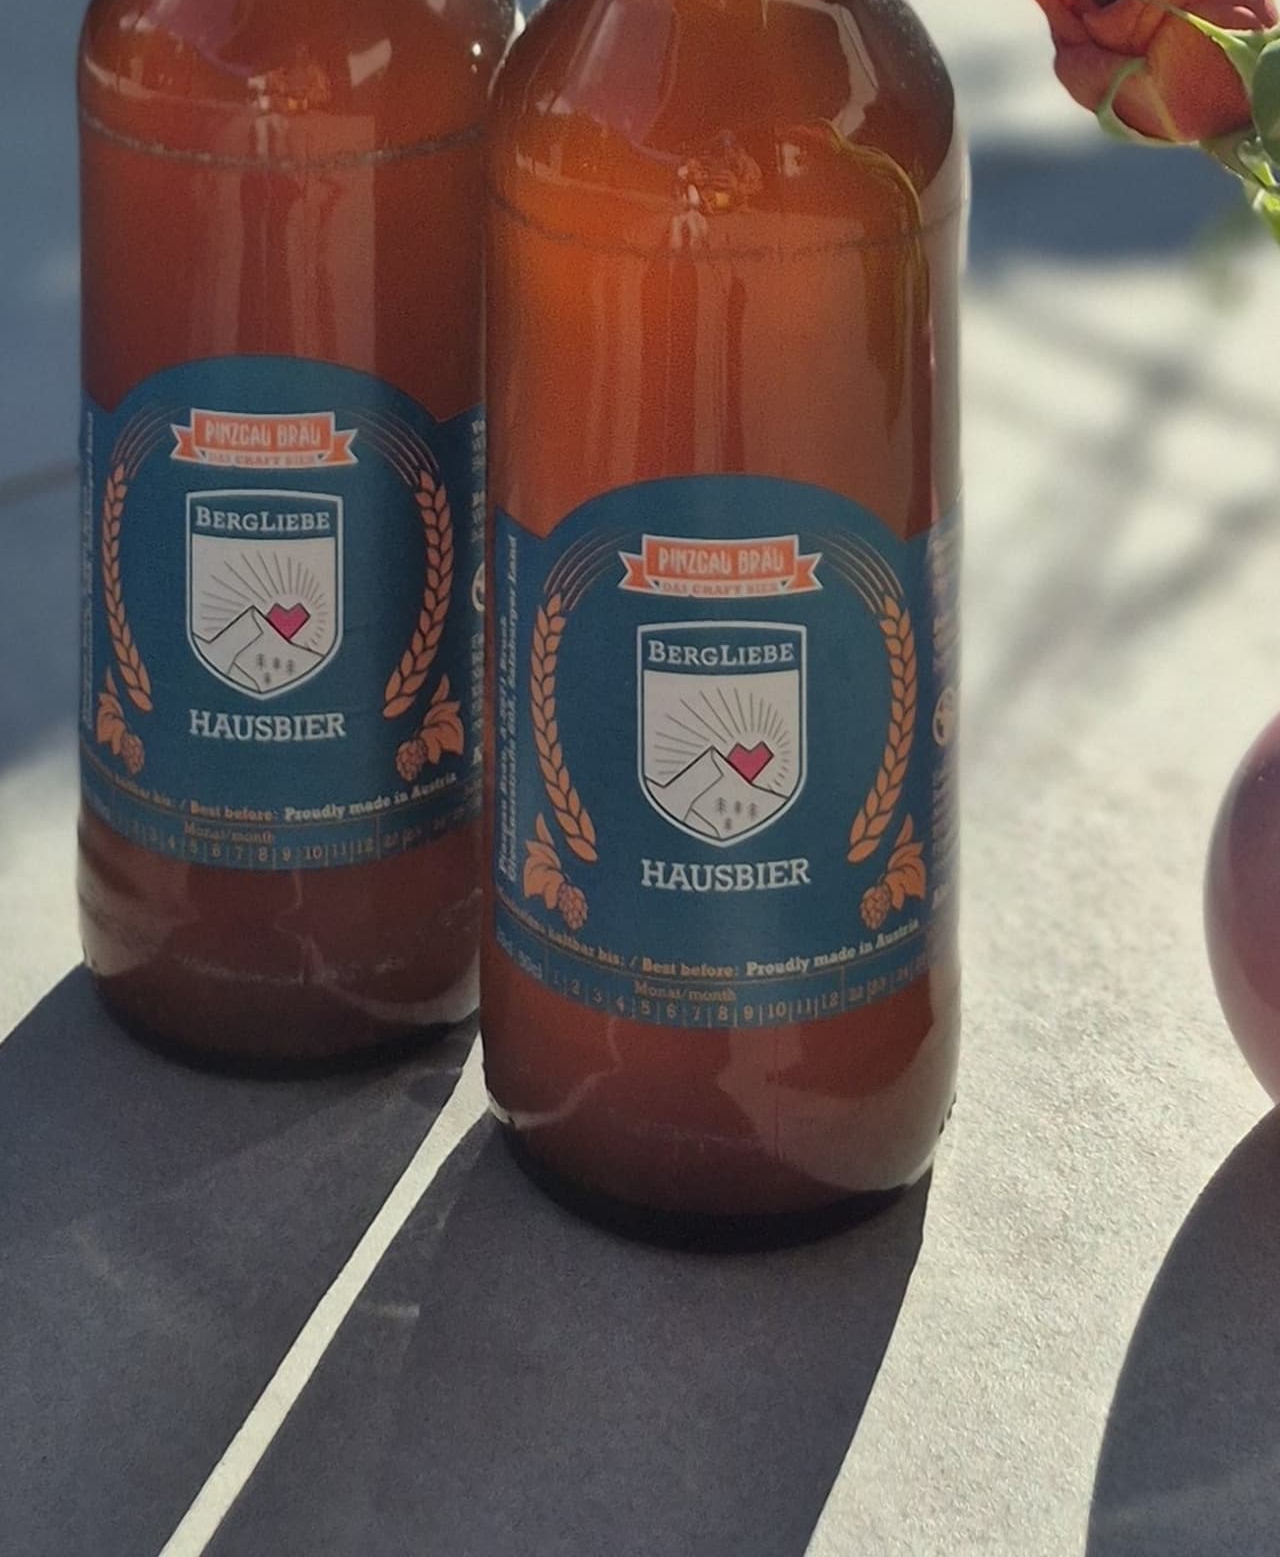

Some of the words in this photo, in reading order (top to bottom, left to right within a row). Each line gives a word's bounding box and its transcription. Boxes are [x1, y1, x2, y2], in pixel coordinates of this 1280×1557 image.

[206, 420, 270, 445] PINZGAU
[277, 419, 321, 446] BRÄU
[659, 546, 731, 574] PINZGAU
[739, 546, 784, 574] BRÄU
[189, 709, 346, 742] HAUSBIER
[190, 800, 220, 817] Best
[284, 804, 347, 822] Proudly
[349, 796, 391, 815] made
[394, 790, 409, 805] in
[411, 772, 457, 801] Austria
[640, 857, 811, 893] HAUSBIER
[745, 956, 810, 977] Proudly
[814, 945, 856, 967] made
[859, 940, 873, 956] in
[875, 918, 919, 949] Austria
[642, 956, 676, 976] Best
[680, 962, 738, 978] before:
[743, 1005, 754, 1020] 9
[767, 1002, 787, 1019] 10
